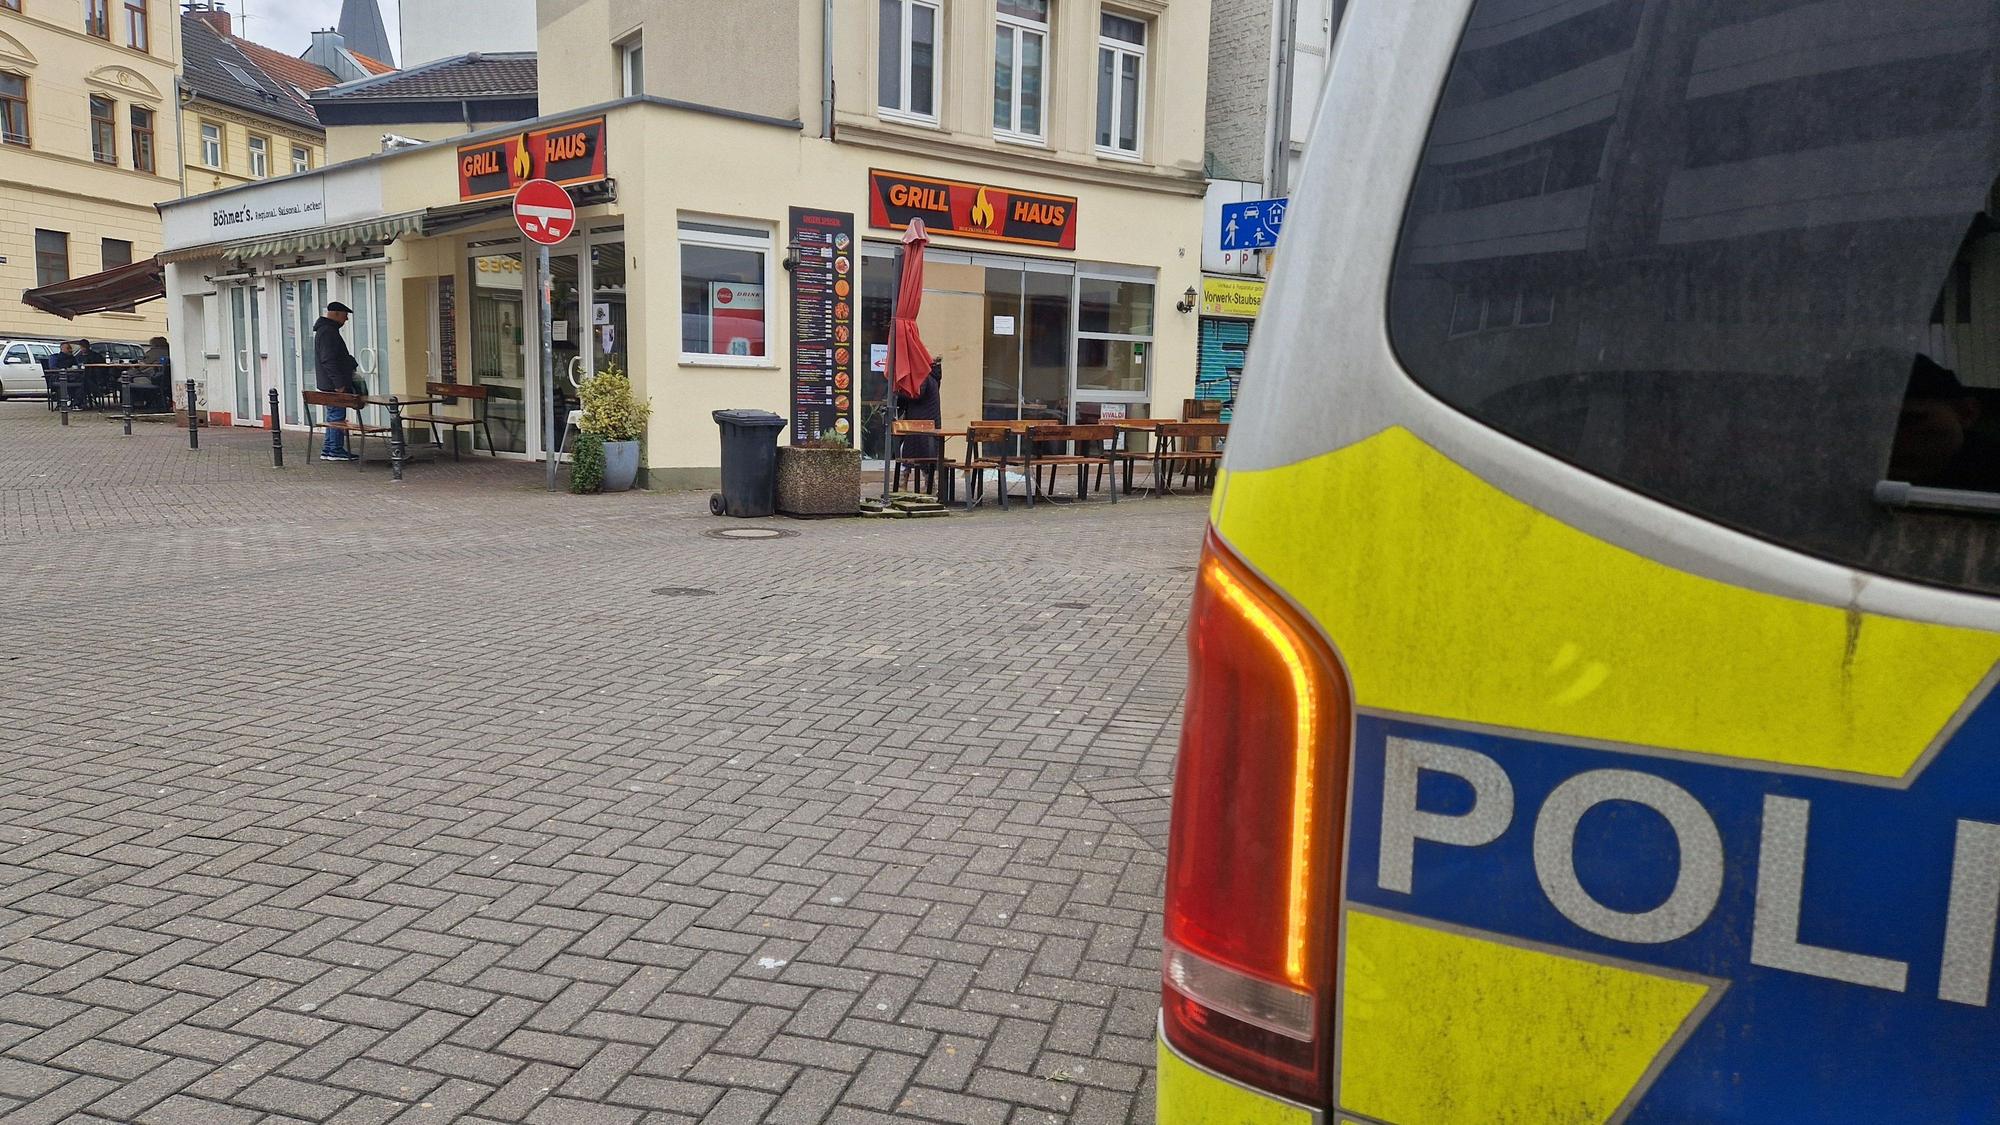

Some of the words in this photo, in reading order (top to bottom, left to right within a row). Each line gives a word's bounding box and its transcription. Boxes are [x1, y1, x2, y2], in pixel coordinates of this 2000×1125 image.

[463, 151, 499, 177] GRILL
[545, 132, 587, 162] HAUS
[889, 184, 949, 211] GRILL
[1014, 200, 1066, 227] HAUS
[1378, 735, 2000, 1007] POLI
